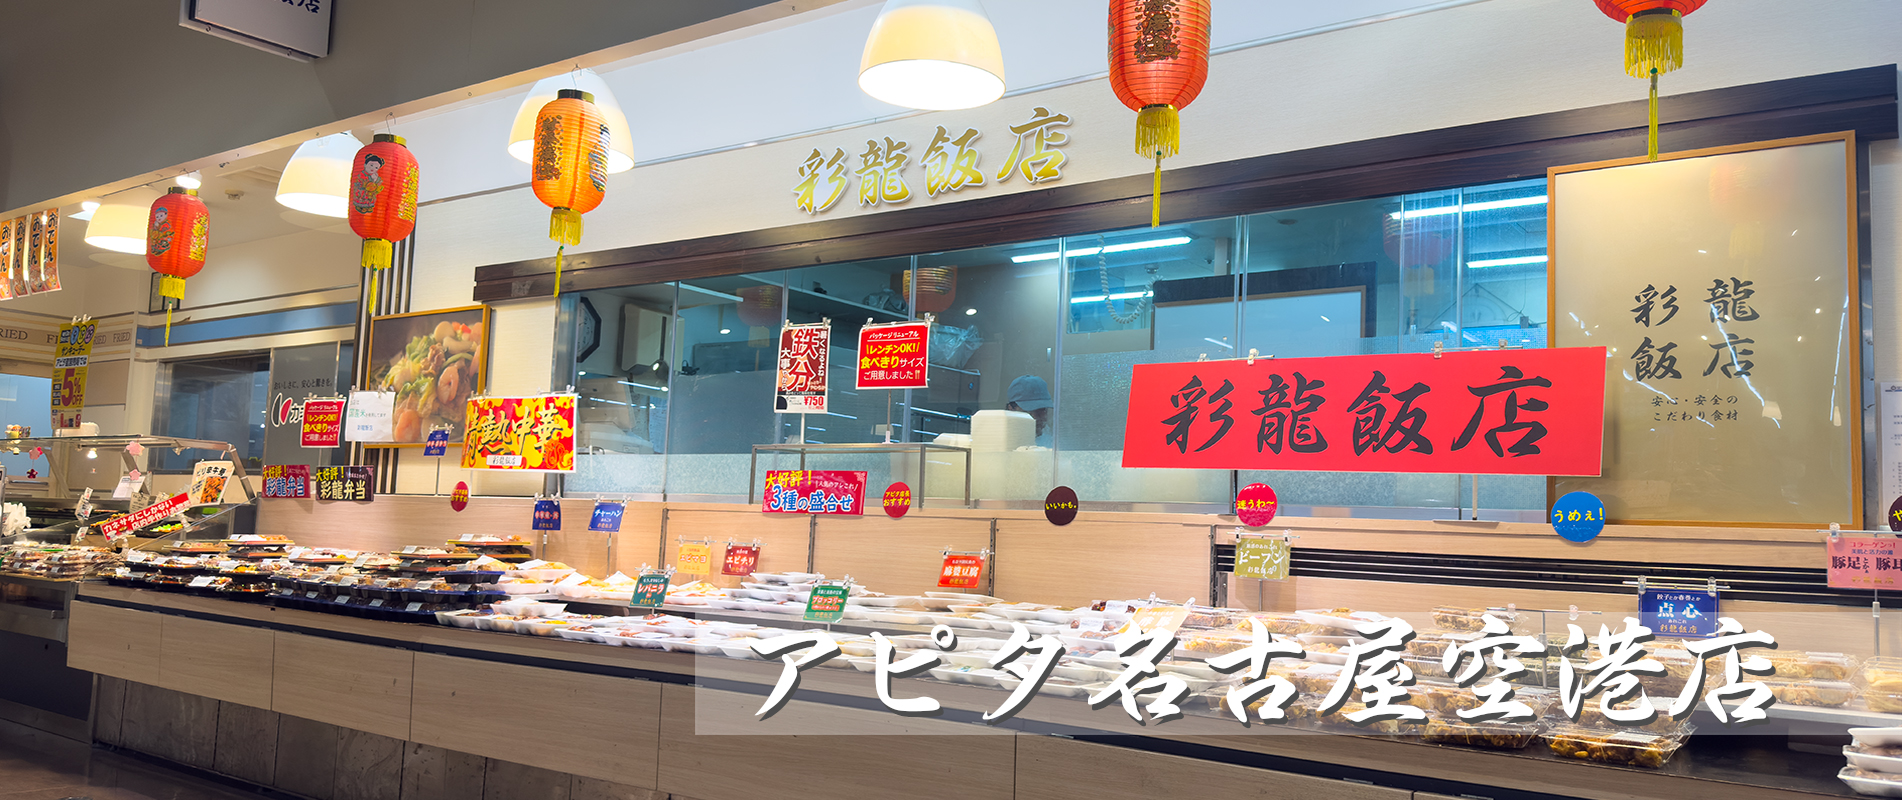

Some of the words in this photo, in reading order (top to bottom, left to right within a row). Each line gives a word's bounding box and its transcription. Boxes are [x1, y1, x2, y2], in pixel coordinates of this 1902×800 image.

[793, 106, 1074, 214] 彩龍飯店
[31, 215, 41, 265] おでん
[47, 212, 58, 262] おでん
[0, 328, 28, 340] RIED
[787, 327, 819, 392] 鉄分
[861, 355, 925, 370] 食べきりサイズ
[804, 396, 824, 406] ¥750
[1161, 365, 1552, 457] 彩龍飯店
[1654, 409, 1739, 421] こだわり食材
[266, 476, 305, 498] 彩龍弁当
[320, 479, 366, 500] 彩龍弁当
[770, 484, 855, 514] 3種の盛合せ
[883, 498, 911, 507] おすすめ
[1045, 501, 1077, 511] いいかも。
[594, 509, 623, 518] チャーハン
[679, 553, 707, 564] エビマヨ
[725, 556, 755, 568] エビチリ
[1239, 550, 1285, 565] ビーフン
[1657, 602, 1702, 618] 点心
